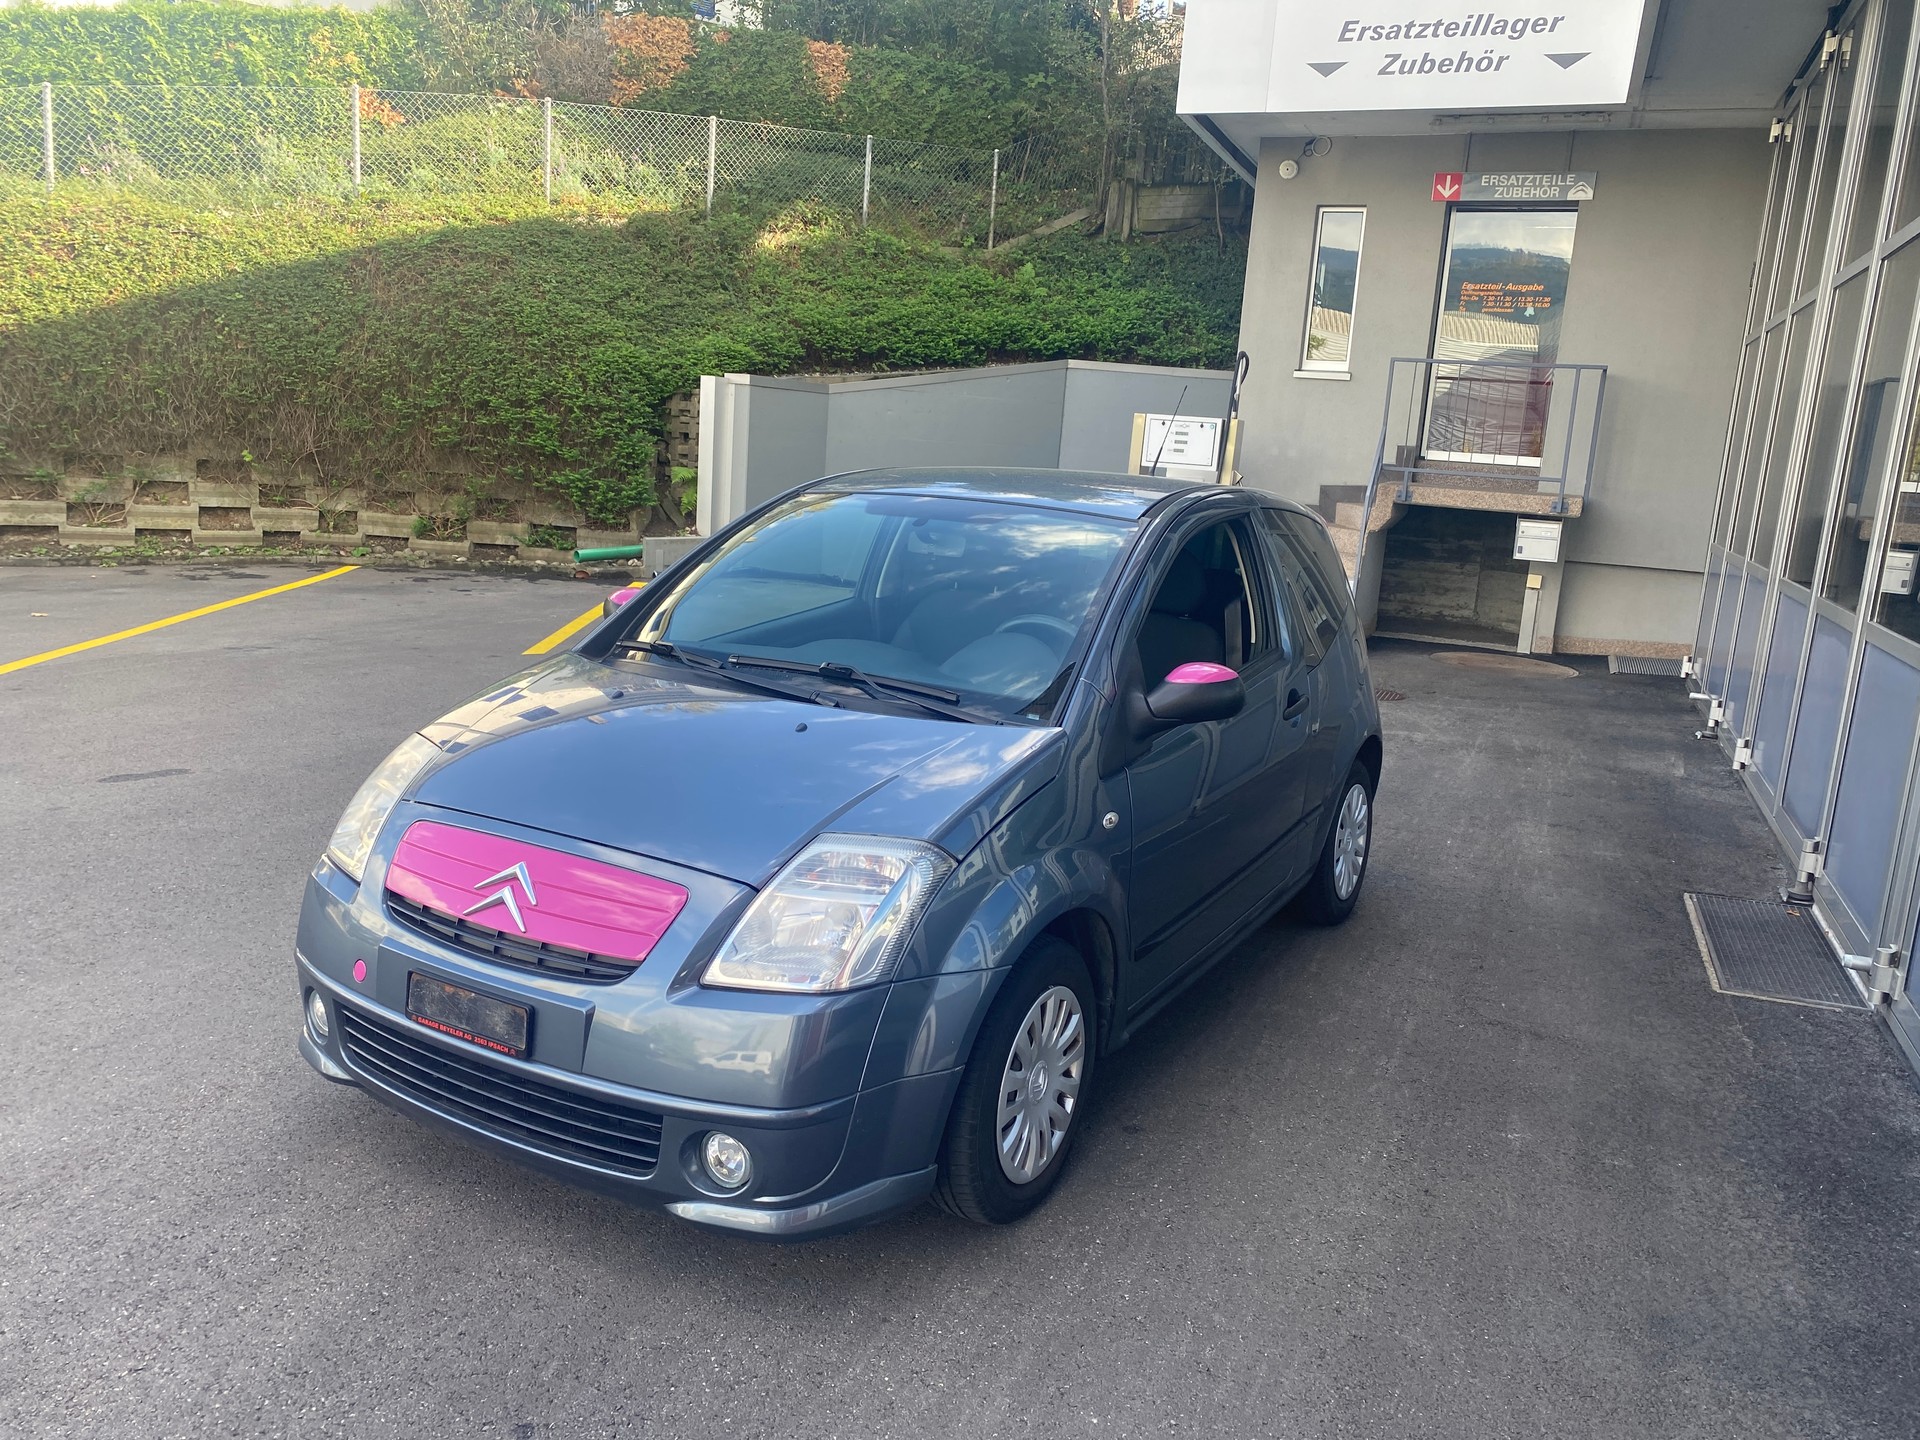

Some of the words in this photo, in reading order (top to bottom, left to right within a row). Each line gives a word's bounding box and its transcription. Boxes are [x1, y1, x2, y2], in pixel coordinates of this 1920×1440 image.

[1338, 13, 1565, 42] Ersatzteillager
[1377, 50, 1510, 76] Zubehör
[1481, 174, 1576, 186] ERSATZTEILE
[1494, 185, 1560, 198] ZUBEHÖR
[418, 1016, 439, 1029] GARAGE
[440, 1023, 464, 1038] BEYELER
[463, 1032, 472, 1041] AG
[488, 1041, 509, 1054] IPSACH
